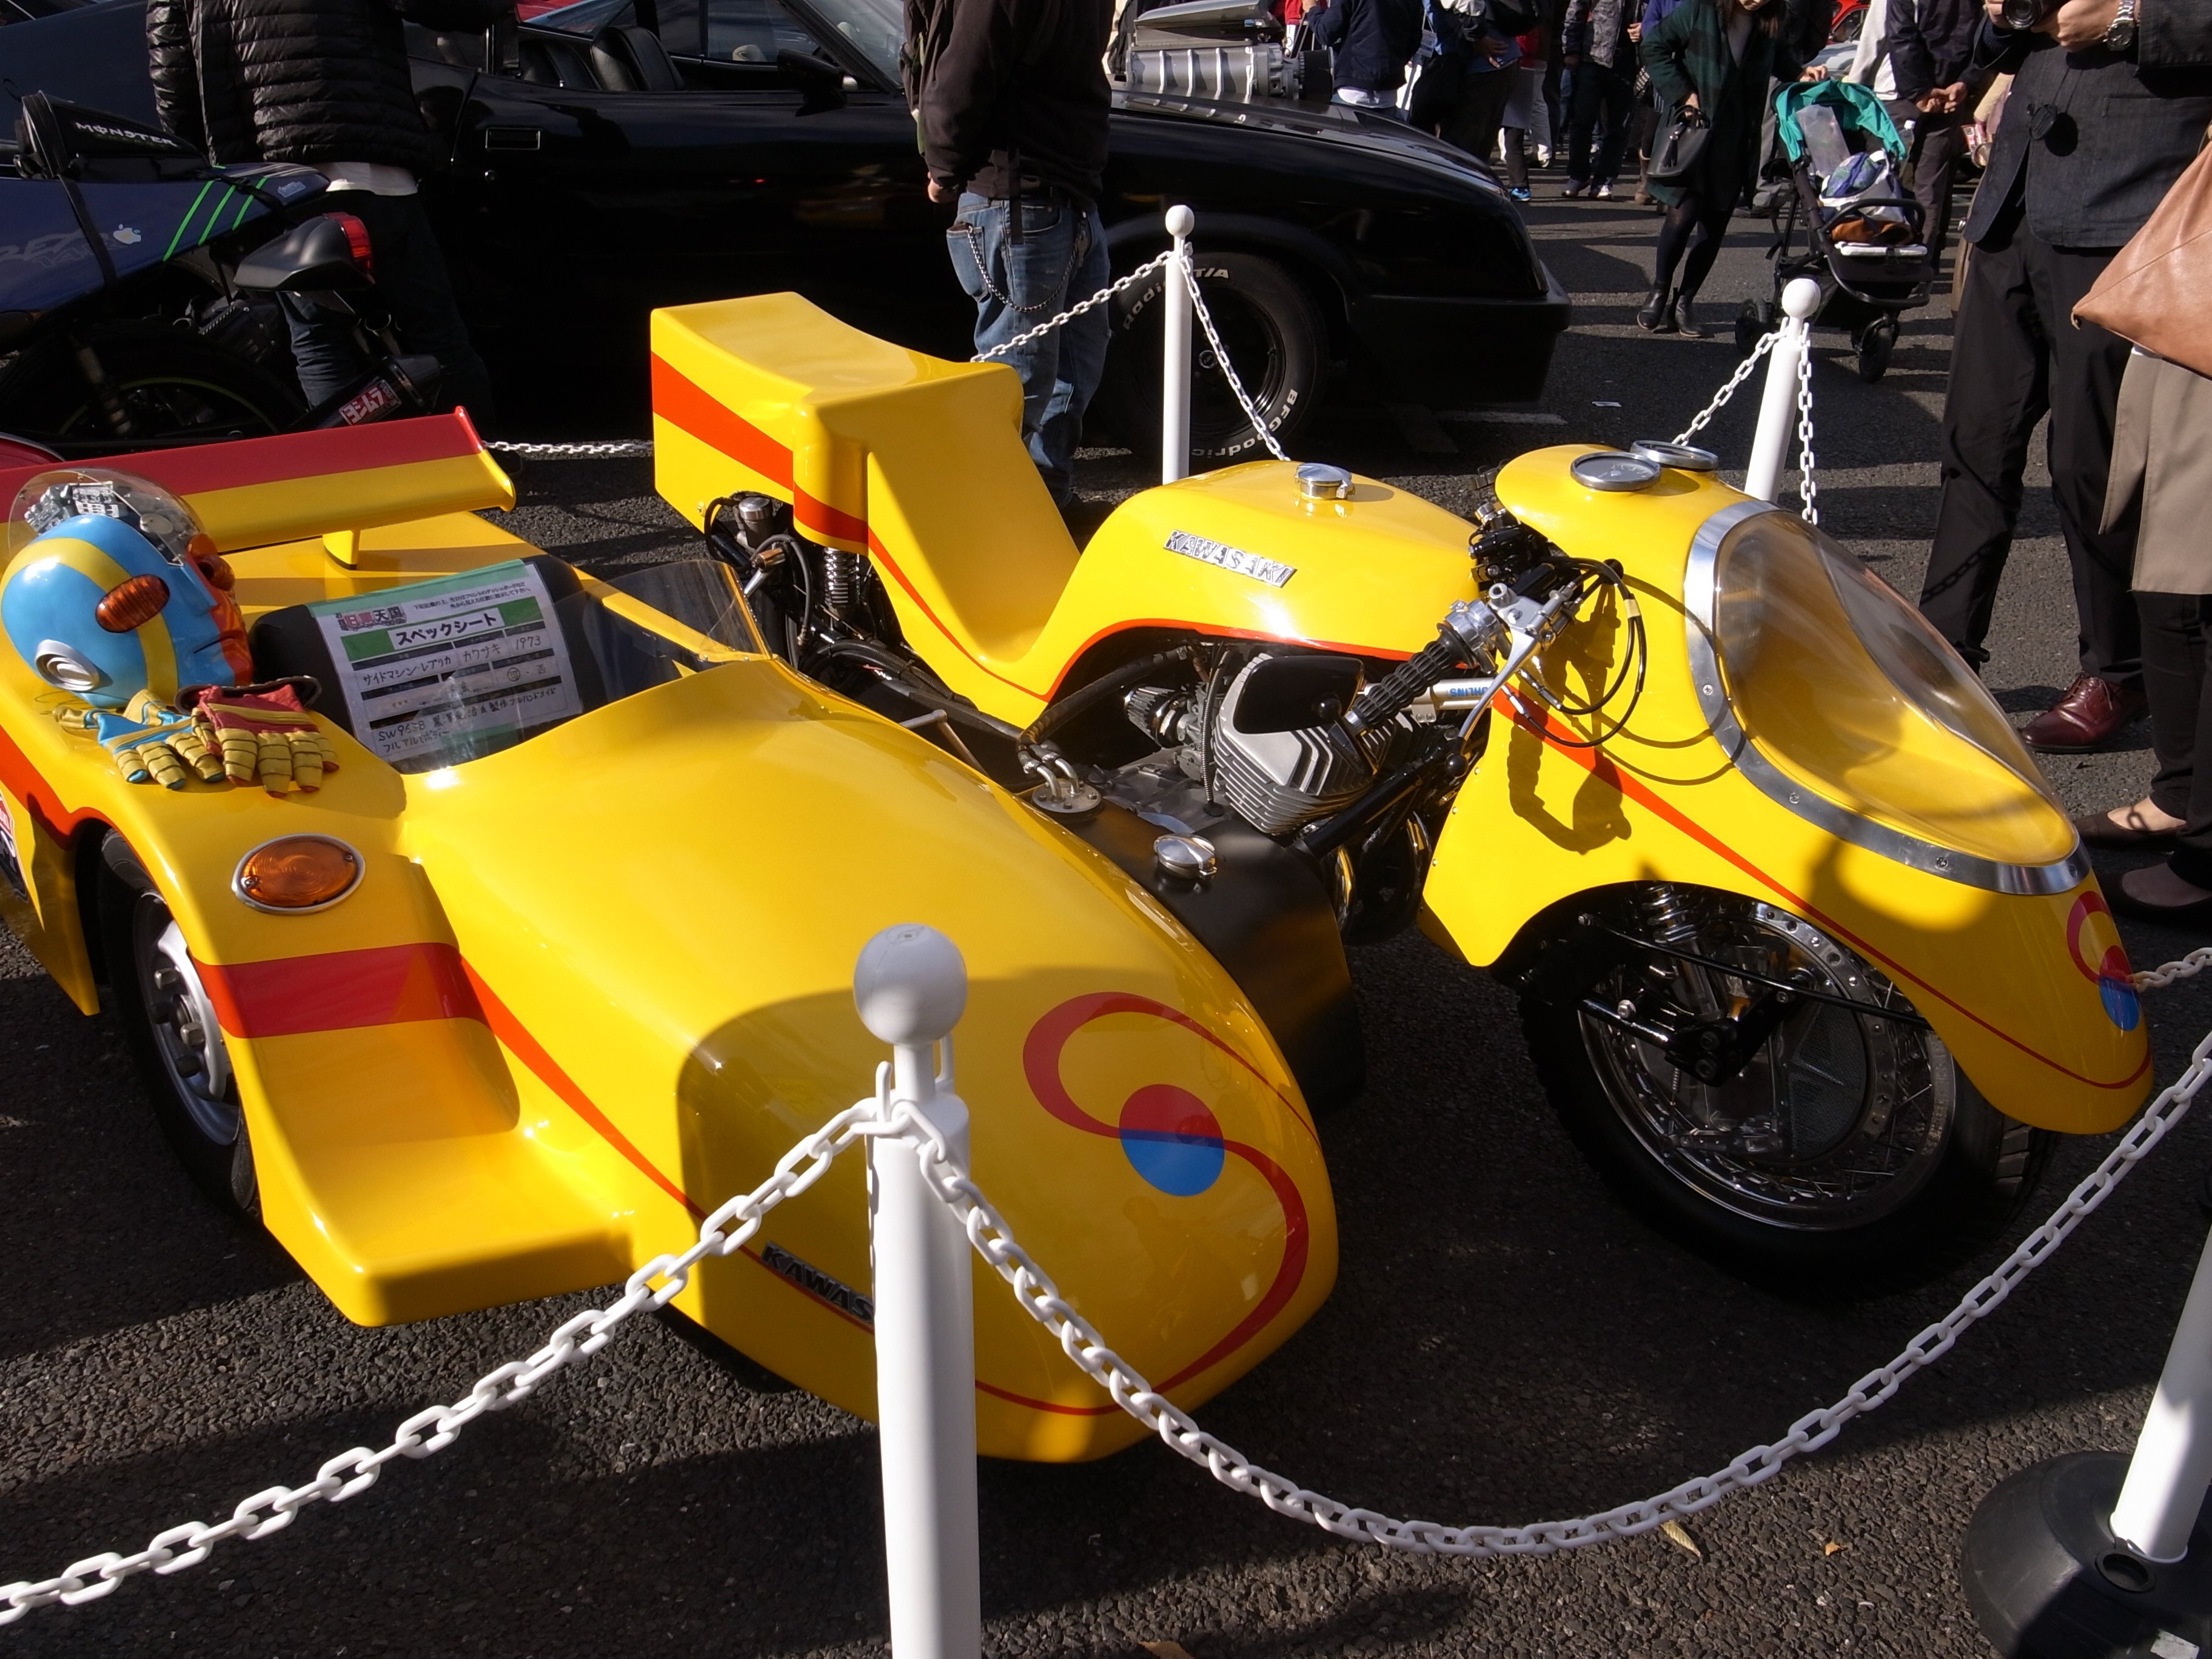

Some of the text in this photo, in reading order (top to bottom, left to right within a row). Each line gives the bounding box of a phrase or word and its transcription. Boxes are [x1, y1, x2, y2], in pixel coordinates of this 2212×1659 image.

[75, 122, 177, 147] MONSTER
[1123, 281, 1166, 330] Radi
[343, 387, 384, 424] ヨシムラ
[1191, 389, 1298, 458] BFGodric
[1165, 531, 1293, 585] KAWASAKI
[395, 612, 497, 645] スペックシート
[515, 634, 541, 649] 1973
[463, 643, 501, 662] カワサキ
[762, 1244, 874, 1323] KAWAS
